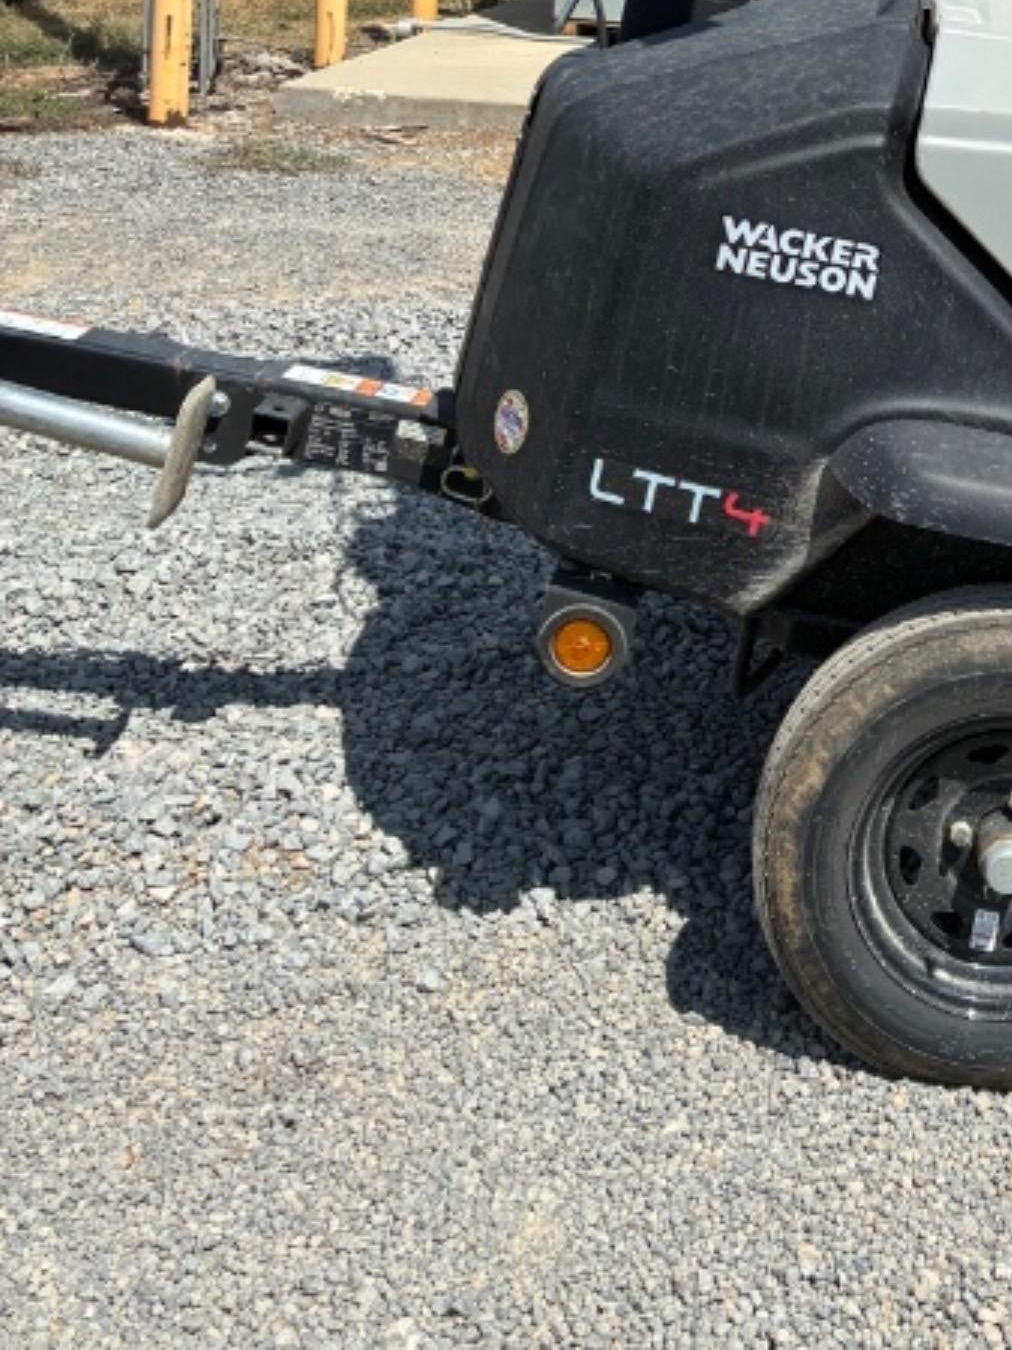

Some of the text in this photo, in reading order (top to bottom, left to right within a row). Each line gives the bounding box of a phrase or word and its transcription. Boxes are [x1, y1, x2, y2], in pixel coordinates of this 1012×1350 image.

[721, 215, 881, 272] WACKER
[715, 246, 877, 301] NEUSON
[589, 458, 771, 538] LTT4
